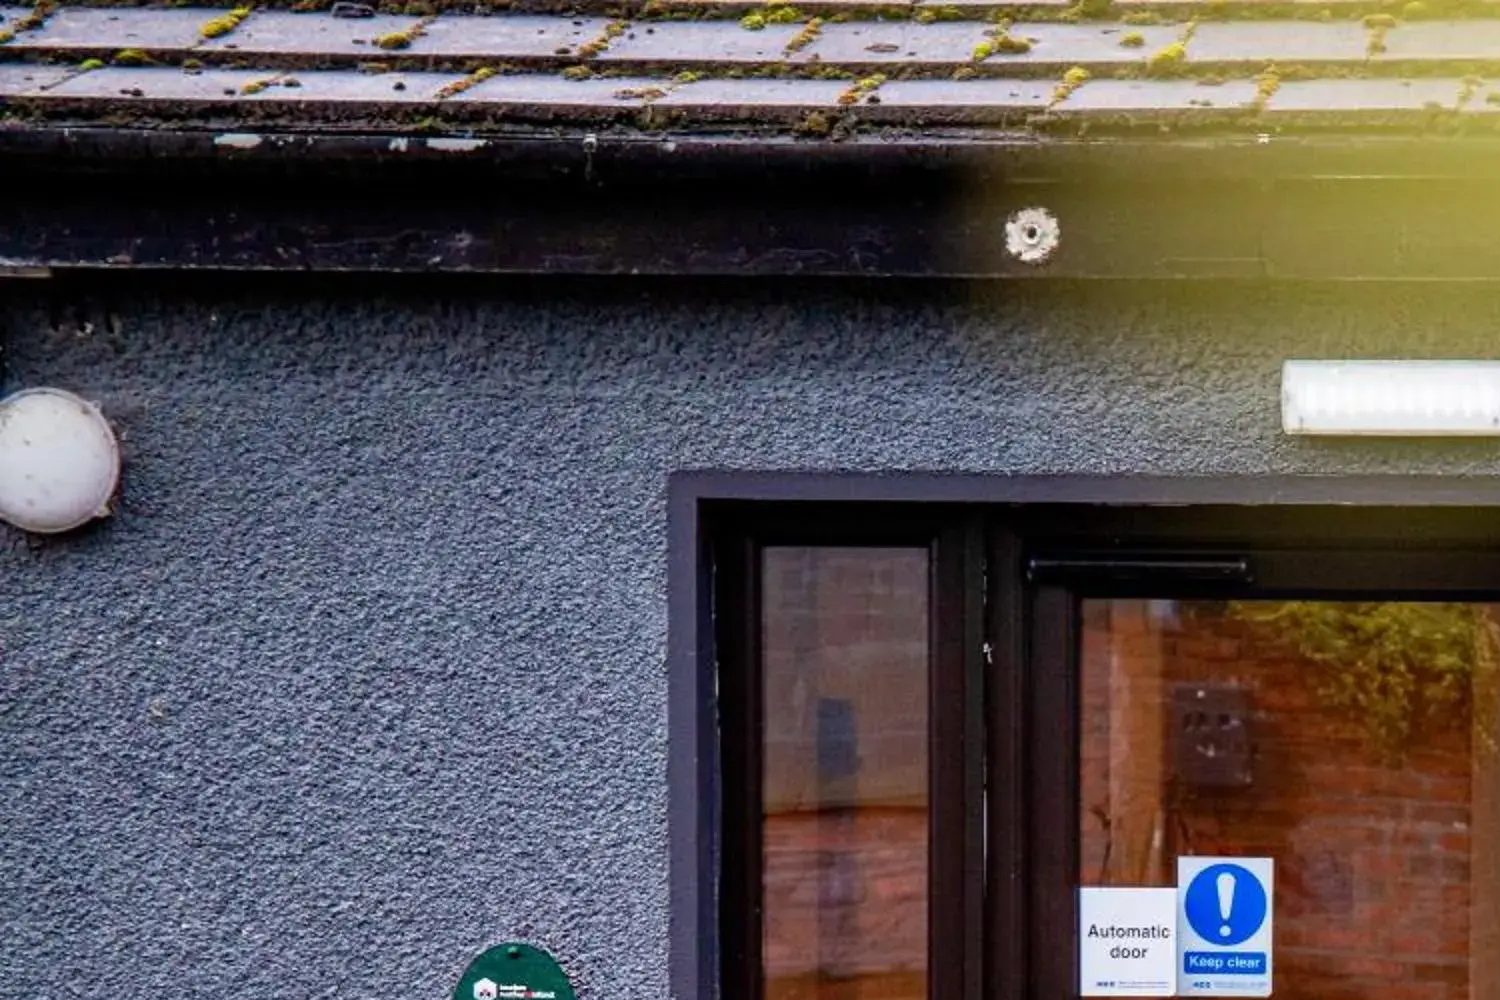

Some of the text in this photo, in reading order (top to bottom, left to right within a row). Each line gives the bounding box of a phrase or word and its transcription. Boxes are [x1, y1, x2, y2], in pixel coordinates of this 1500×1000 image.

[1087, 923, 1170, 939] Automatic
[1109, 945, 1148, 959] door
[1189, 955, 1261, 969] Keep clear
